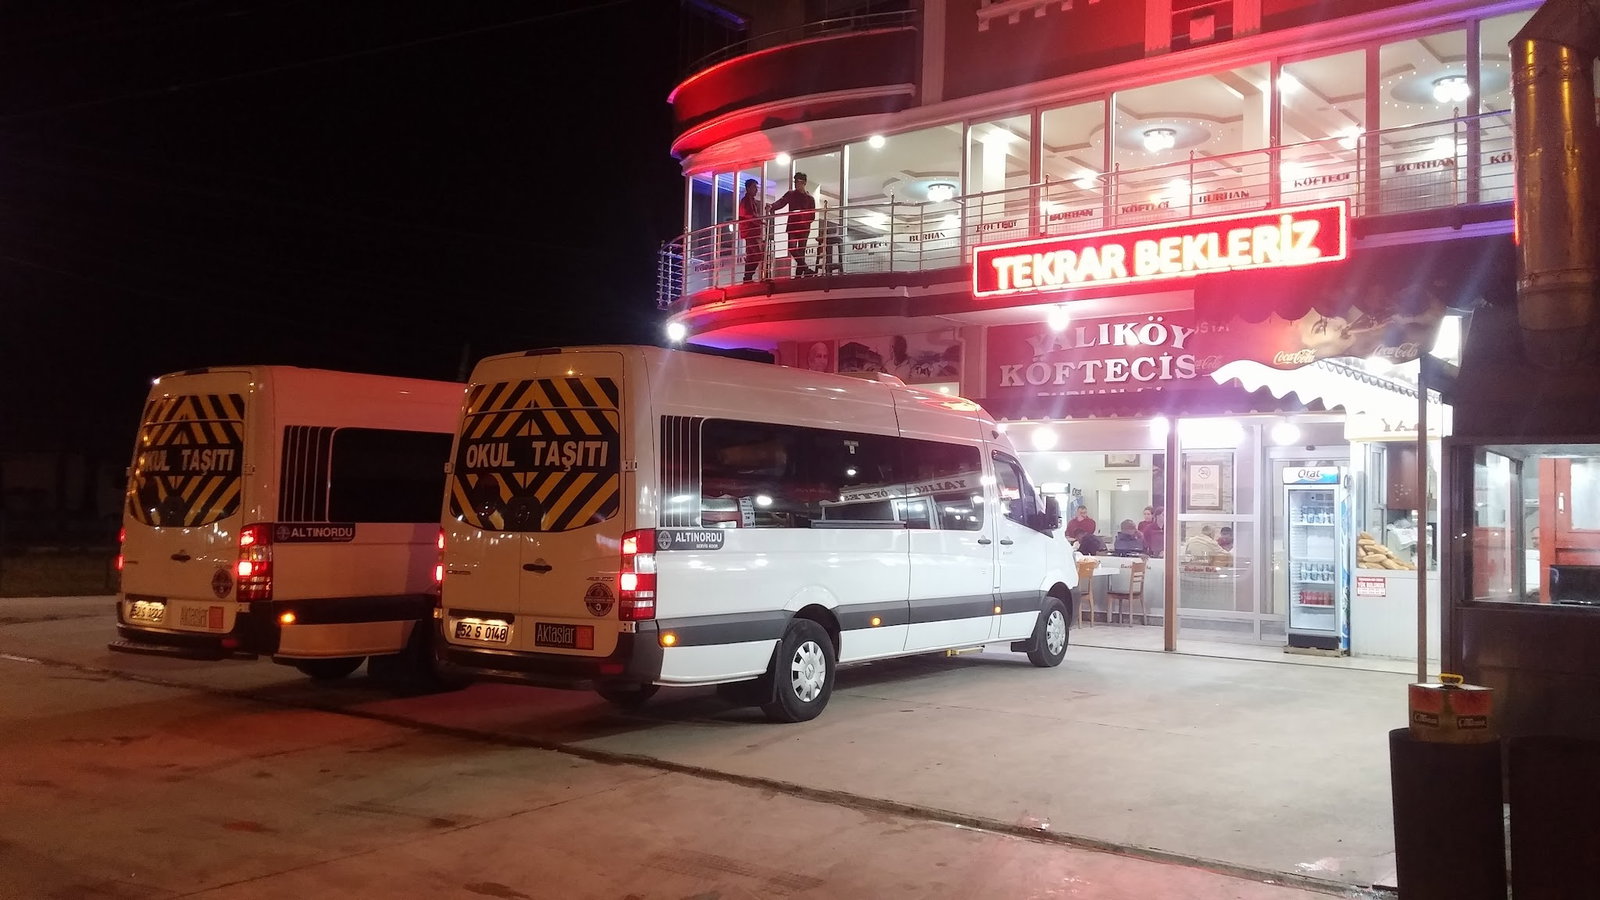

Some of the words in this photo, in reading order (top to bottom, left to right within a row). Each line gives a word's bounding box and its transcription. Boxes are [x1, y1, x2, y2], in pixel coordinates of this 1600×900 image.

[1395, 156, 1456, 173] BURHAN
[1199, 190, 1250, 203] BURHAN
[909, 231, 946, 243] BURHAN
[993, 244, 1126, 290] TEKRAR
[1136, 214, 1321, 276] BEKLERİZ
[1025, 316, 1195, 356] YALIKÖY
[1273, 348, 1317, 366] Coca-Cola
[1000, 352, 1197, 387] KÖFTECİS
[181, 449, 235, 475] TAŞITI
[465, 443, 516, 468] OKUL
[531, 441, 609, 472] TAŞITI
[291, 527, 353, 537] ALTINORDU
[675, 532, 722, 542] ALTINORDU
[461, 624, 472, 637] 52
[475, 626, 482, 638] S
[485, 626, 506, 640] 0148
